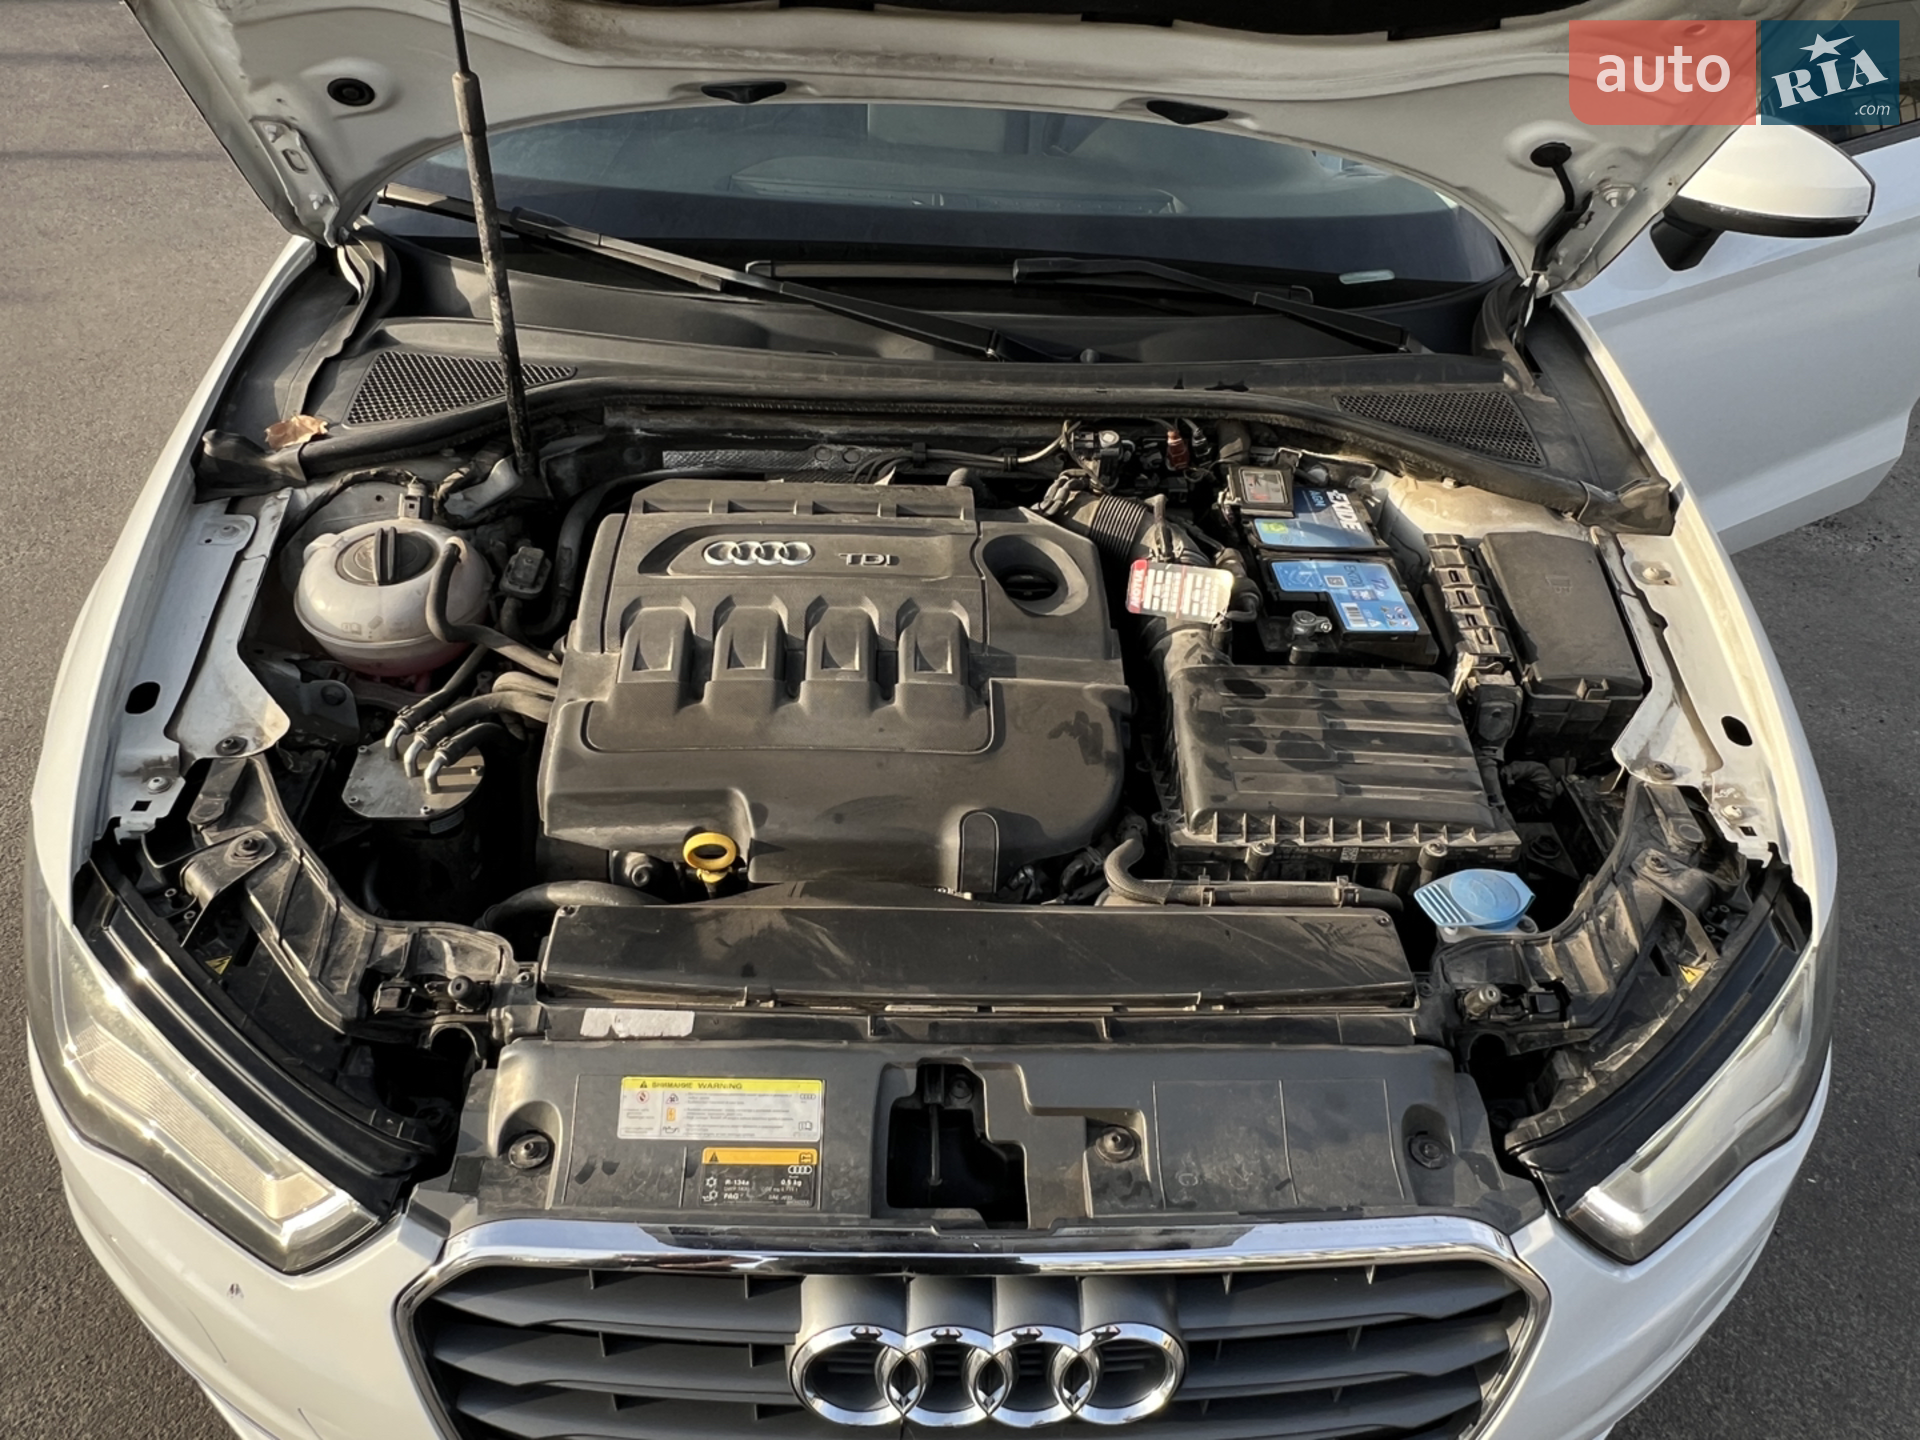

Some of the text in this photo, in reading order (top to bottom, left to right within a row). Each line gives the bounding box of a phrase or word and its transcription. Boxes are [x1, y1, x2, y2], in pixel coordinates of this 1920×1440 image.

[1309, 490, 1327, 507] AGM
[1326, 489, 1364, 532] EXIDE
[838, 552, 891, 567] TDI
[1130, 568, 1145, 609] MOTUL
[698, 1082, 743, 1090] WARNING
